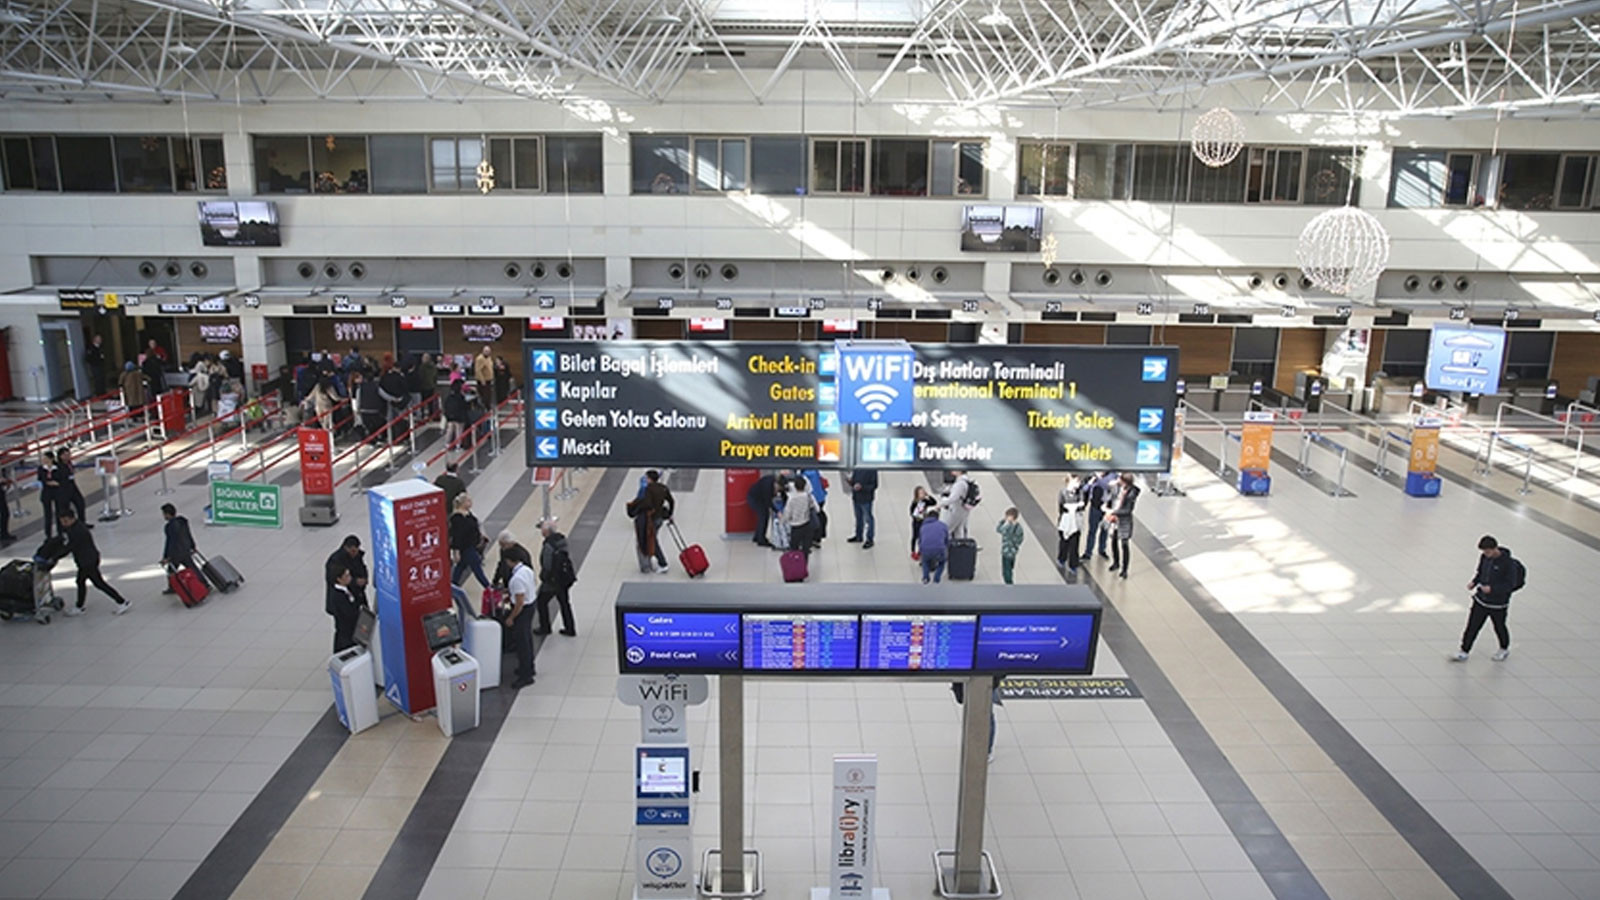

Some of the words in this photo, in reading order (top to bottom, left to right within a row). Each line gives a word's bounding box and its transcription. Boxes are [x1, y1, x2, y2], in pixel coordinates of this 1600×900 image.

[560, 354, 596, 373] Bilet
[601, 355, 645, 377] Bagaj
[650, 351, 719, 376] İşlemleri
[748, 355, 816, 374] Check-in
[845, 355, 910, 381] WiFi
[913, 361, 936, 384] Dış
[940, 361, 989, 380] Hatlar
[994, 362, 1065, 381] Terminali
[561, 382, 617, 402] Kapılar
[770, 384, 815, 401] Gates
[913, 381, 993, 399] ernational
[998, 382, 1063, 399] Terminal
[1068, 383, 1077, 399] 1
[561, 410, 607, 428] Gelen
[609, 409, 650, 428] Yolcu
[653, 410, 706, 428] Salonu
[726, 411, 777, 430] Arrival
[782, 411, 815, 430] Hall
[931, 409, 968, 432] Satış
[1027, 411, 1070, 429] Ticket
[1075, 412, 1114, 430] Sales
[562, 438, 611, 456] Mescit
[721, 440, 770, 459] Prayer
[774, 444, 814, 458] room
[918, 441, 993, 460] Tuvaletler
[1064, 443, 1112, 461] Toilets
[217, 500, 259, 512] SHELTER
[407, 534, 415, 548] 1
[410, 566, 419, 580] 2
[648, 616, 673, 624] Gates
[650, 651, 671, 659] Food
[673, 651, 697, 659] Court
[998, 652, 1040, 661] Pharmacy
[638, 684, 688, 700] WiFi
[1041, 679, 1125, 688] DOMESTIC
[1079, 688, 1110, 696] HAT
